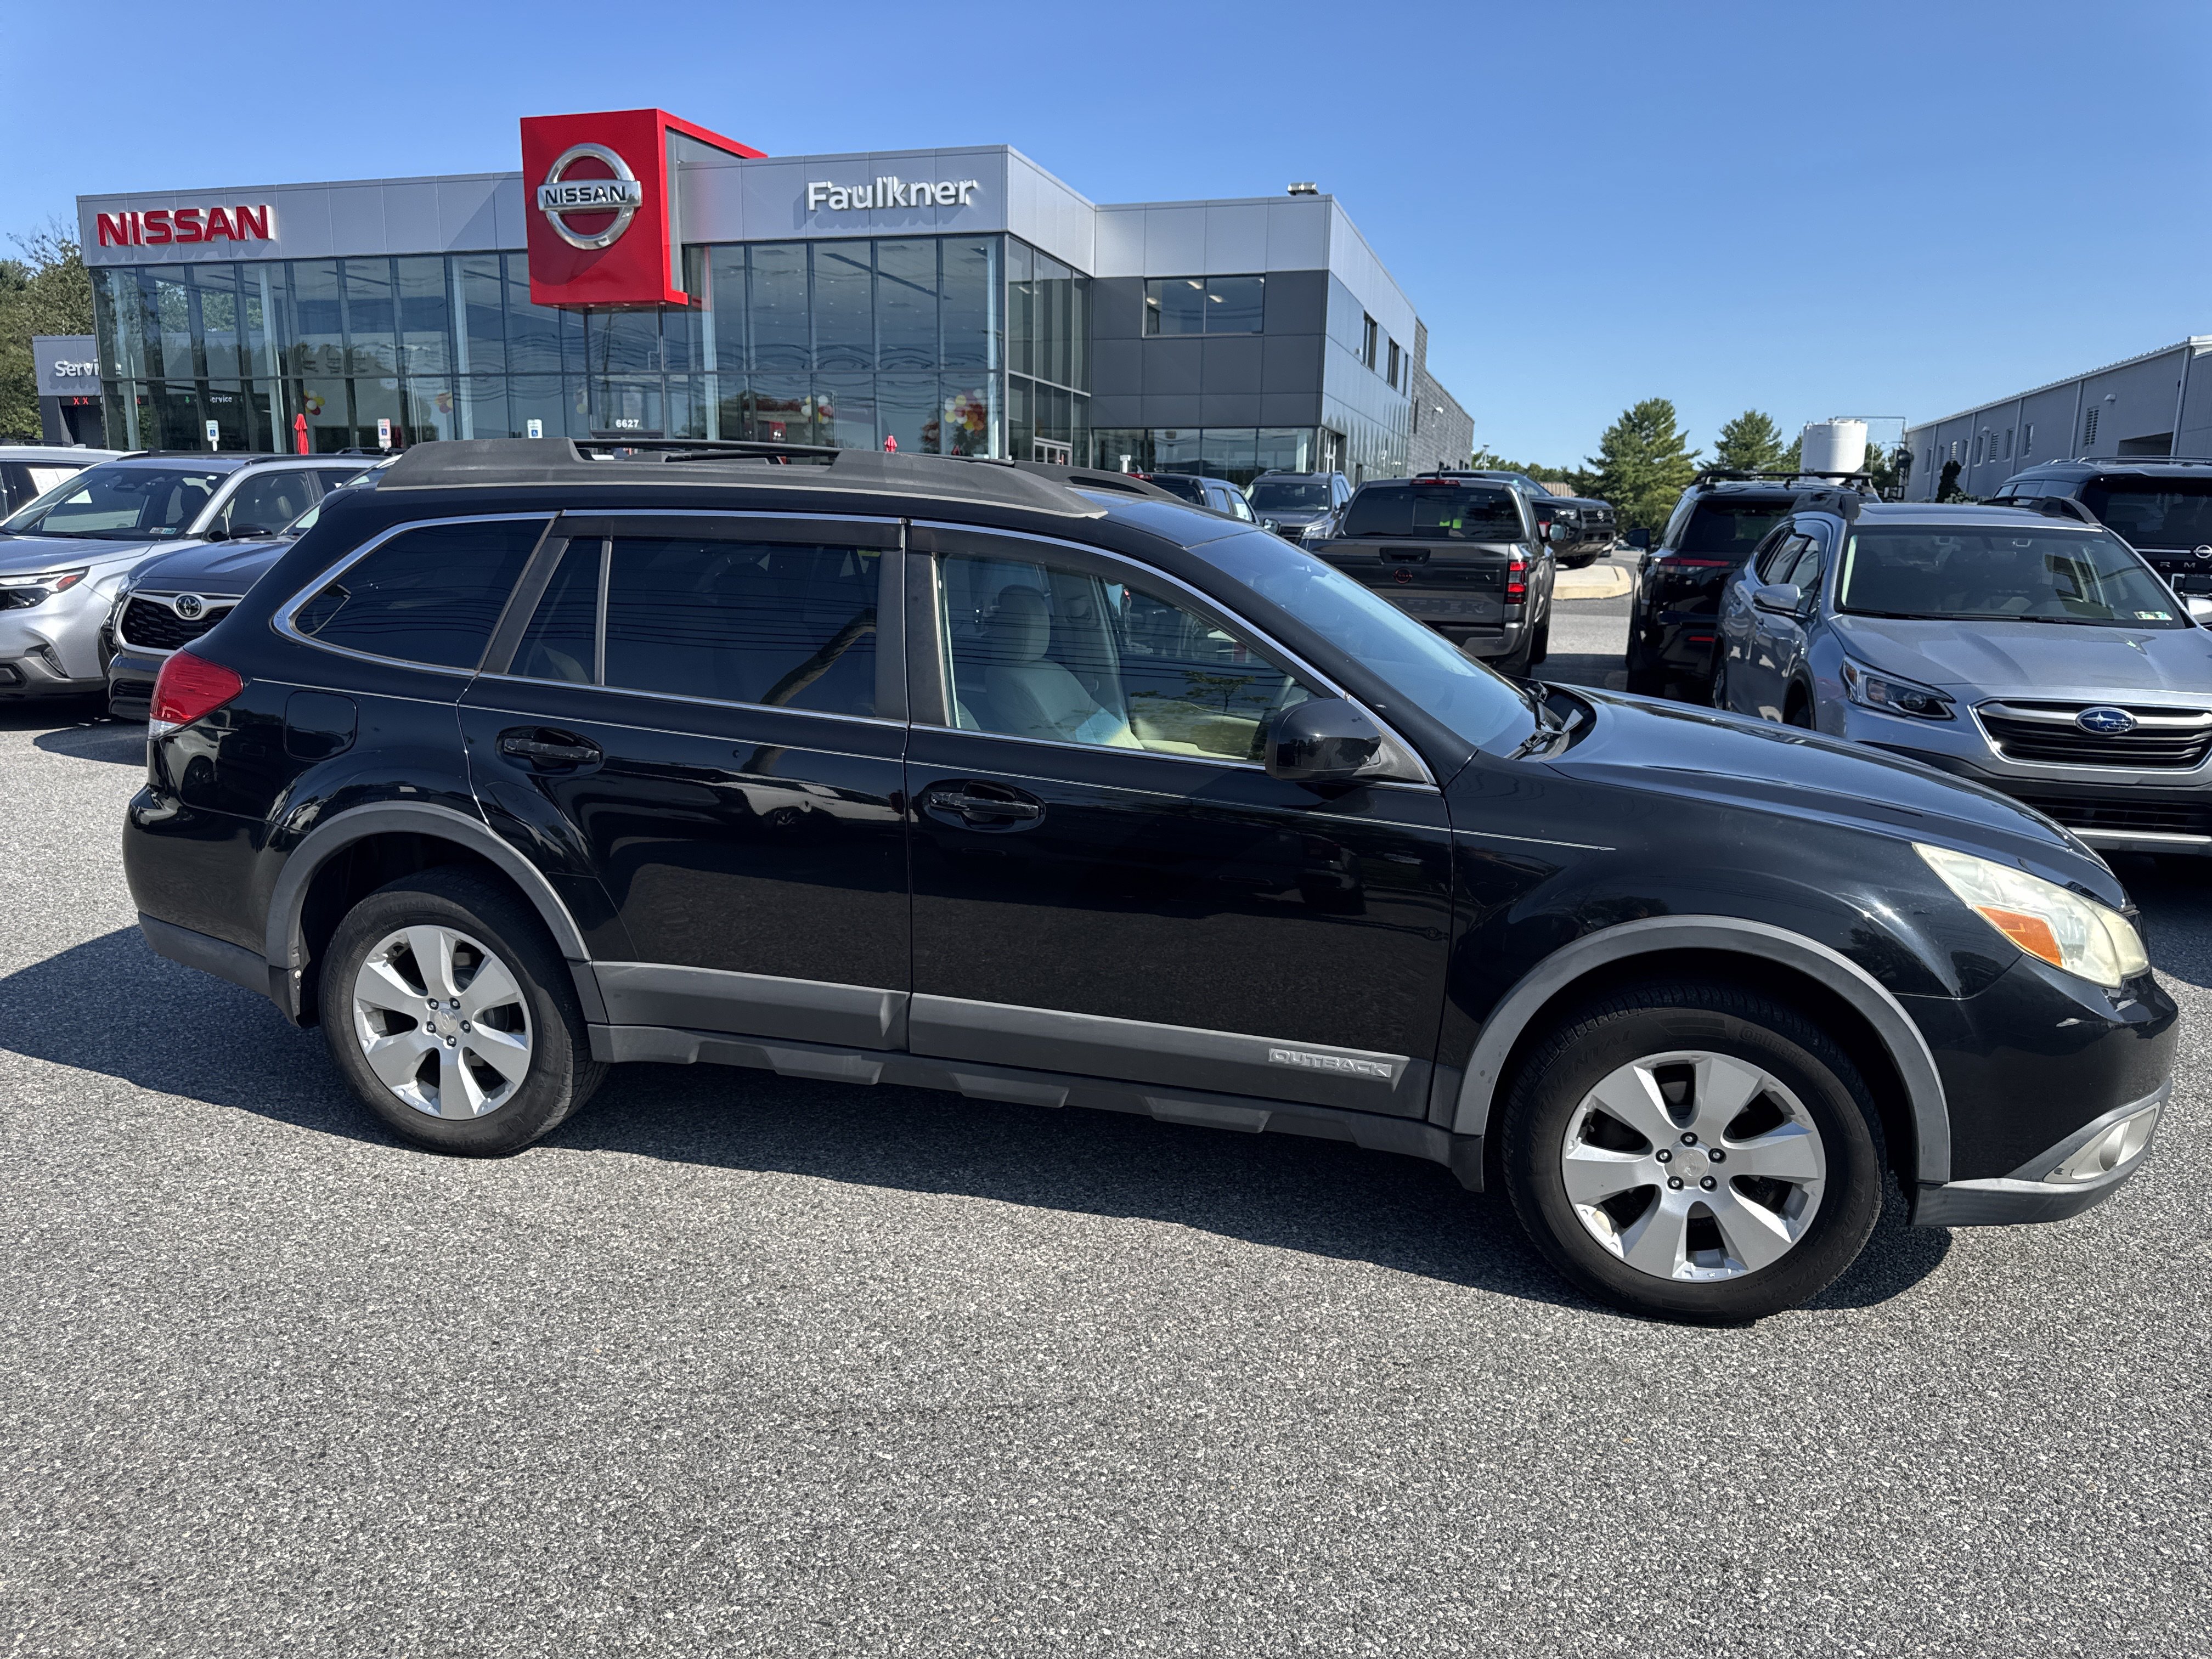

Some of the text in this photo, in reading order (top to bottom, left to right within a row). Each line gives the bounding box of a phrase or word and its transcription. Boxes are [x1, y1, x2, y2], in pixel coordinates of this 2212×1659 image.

[545, 185, 627, 204] NISSAN
[808, 176, 975, 211] Faulkner
[97, 205, 269, 247] NISSAN
[55, 358, 122, 377] Servie
[210, 395, 232, 403] ervice
[615, 419, 639, 428] 6627
[1271, 1049, 1391, 1077] OUTBACK
[1527, 1029, 1635, 1176] CONTINENTAL
